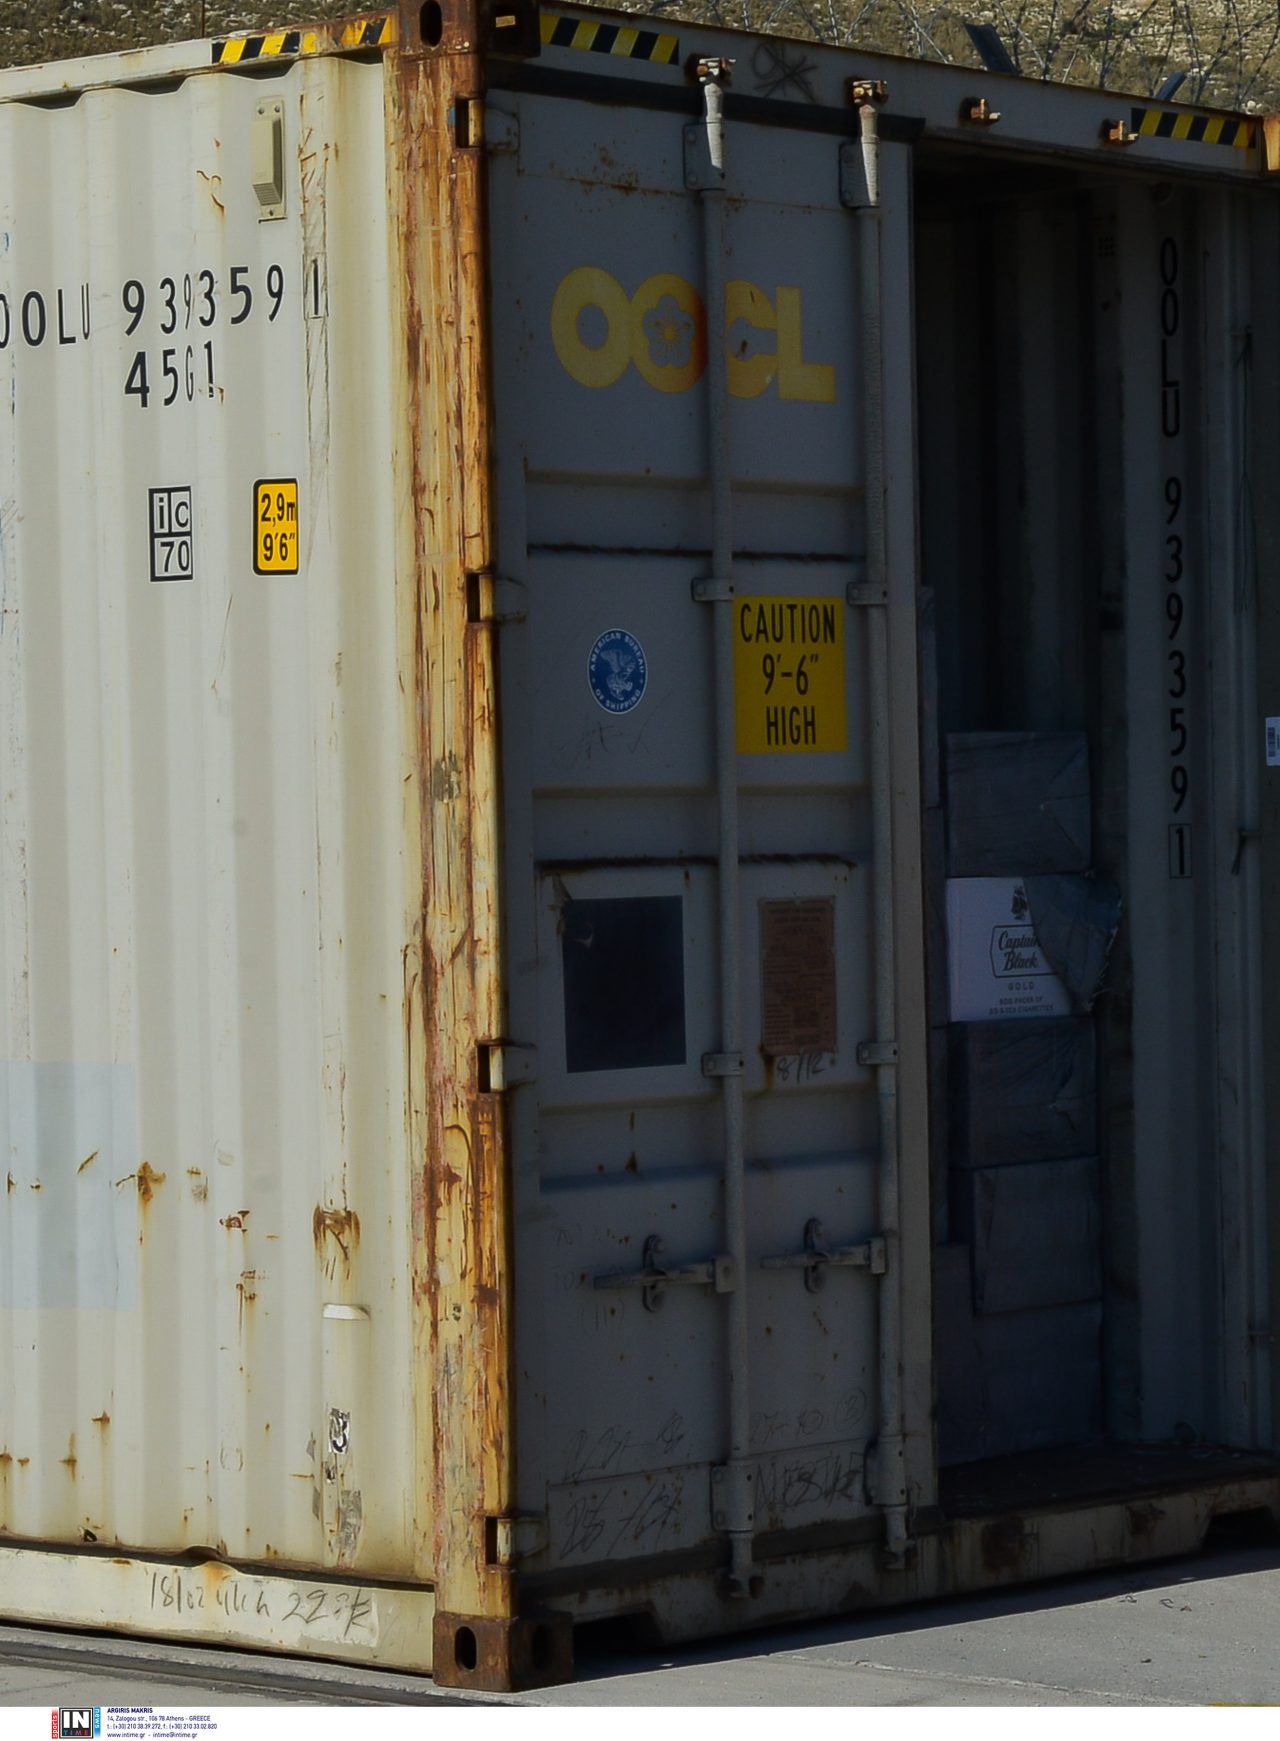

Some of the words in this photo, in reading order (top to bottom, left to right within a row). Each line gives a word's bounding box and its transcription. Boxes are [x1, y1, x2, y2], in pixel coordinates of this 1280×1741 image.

[551, 265, 836, 403] OOCL
[1160, 236, 1181, 438] OOLU
[124, 340, 215, 408] 45G1
[160, 540, 189, 573] 70
[740, 603, 837, 645] CAUTION
[590, 631, 622, 672] AMERICAN
[624, 634, 645, 673] BUREAU
[595, 688, 605, 701] OF
[605, 689, 642, 711] SHIPPING
[766, 706, 817, 746] HIGH
[1003, 951, 1039, 971] Black
[1008, 982, 1035, 991] GOLD
